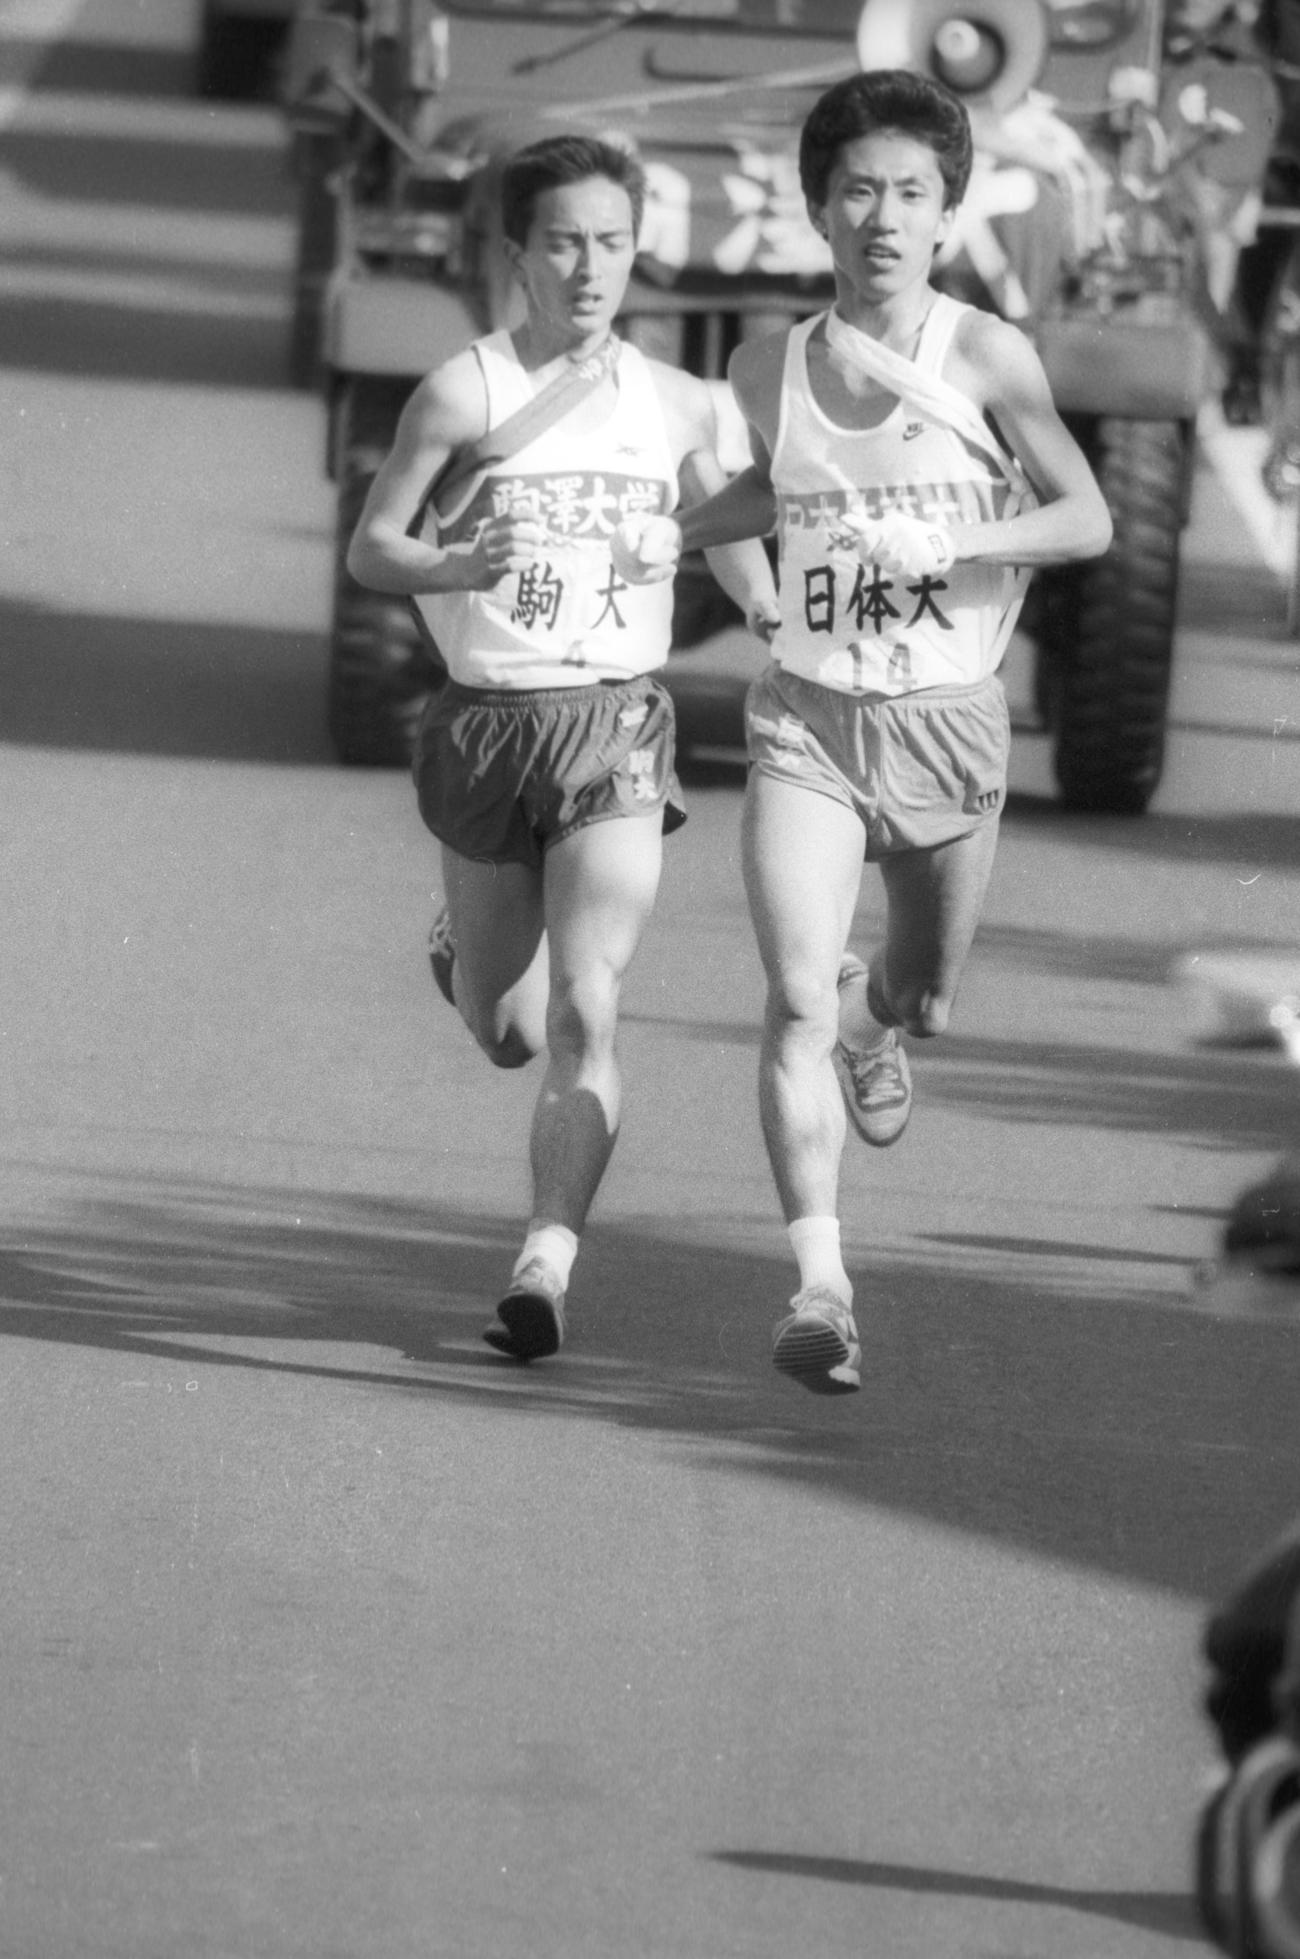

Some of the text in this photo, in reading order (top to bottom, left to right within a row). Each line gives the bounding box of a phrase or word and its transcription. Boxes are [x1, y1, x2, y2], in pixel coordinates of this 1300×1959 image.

[511, 562, 628, 631] 駒大
[804, 563, 955, 634] 日体大
[847, 642, 918, 691] 14
